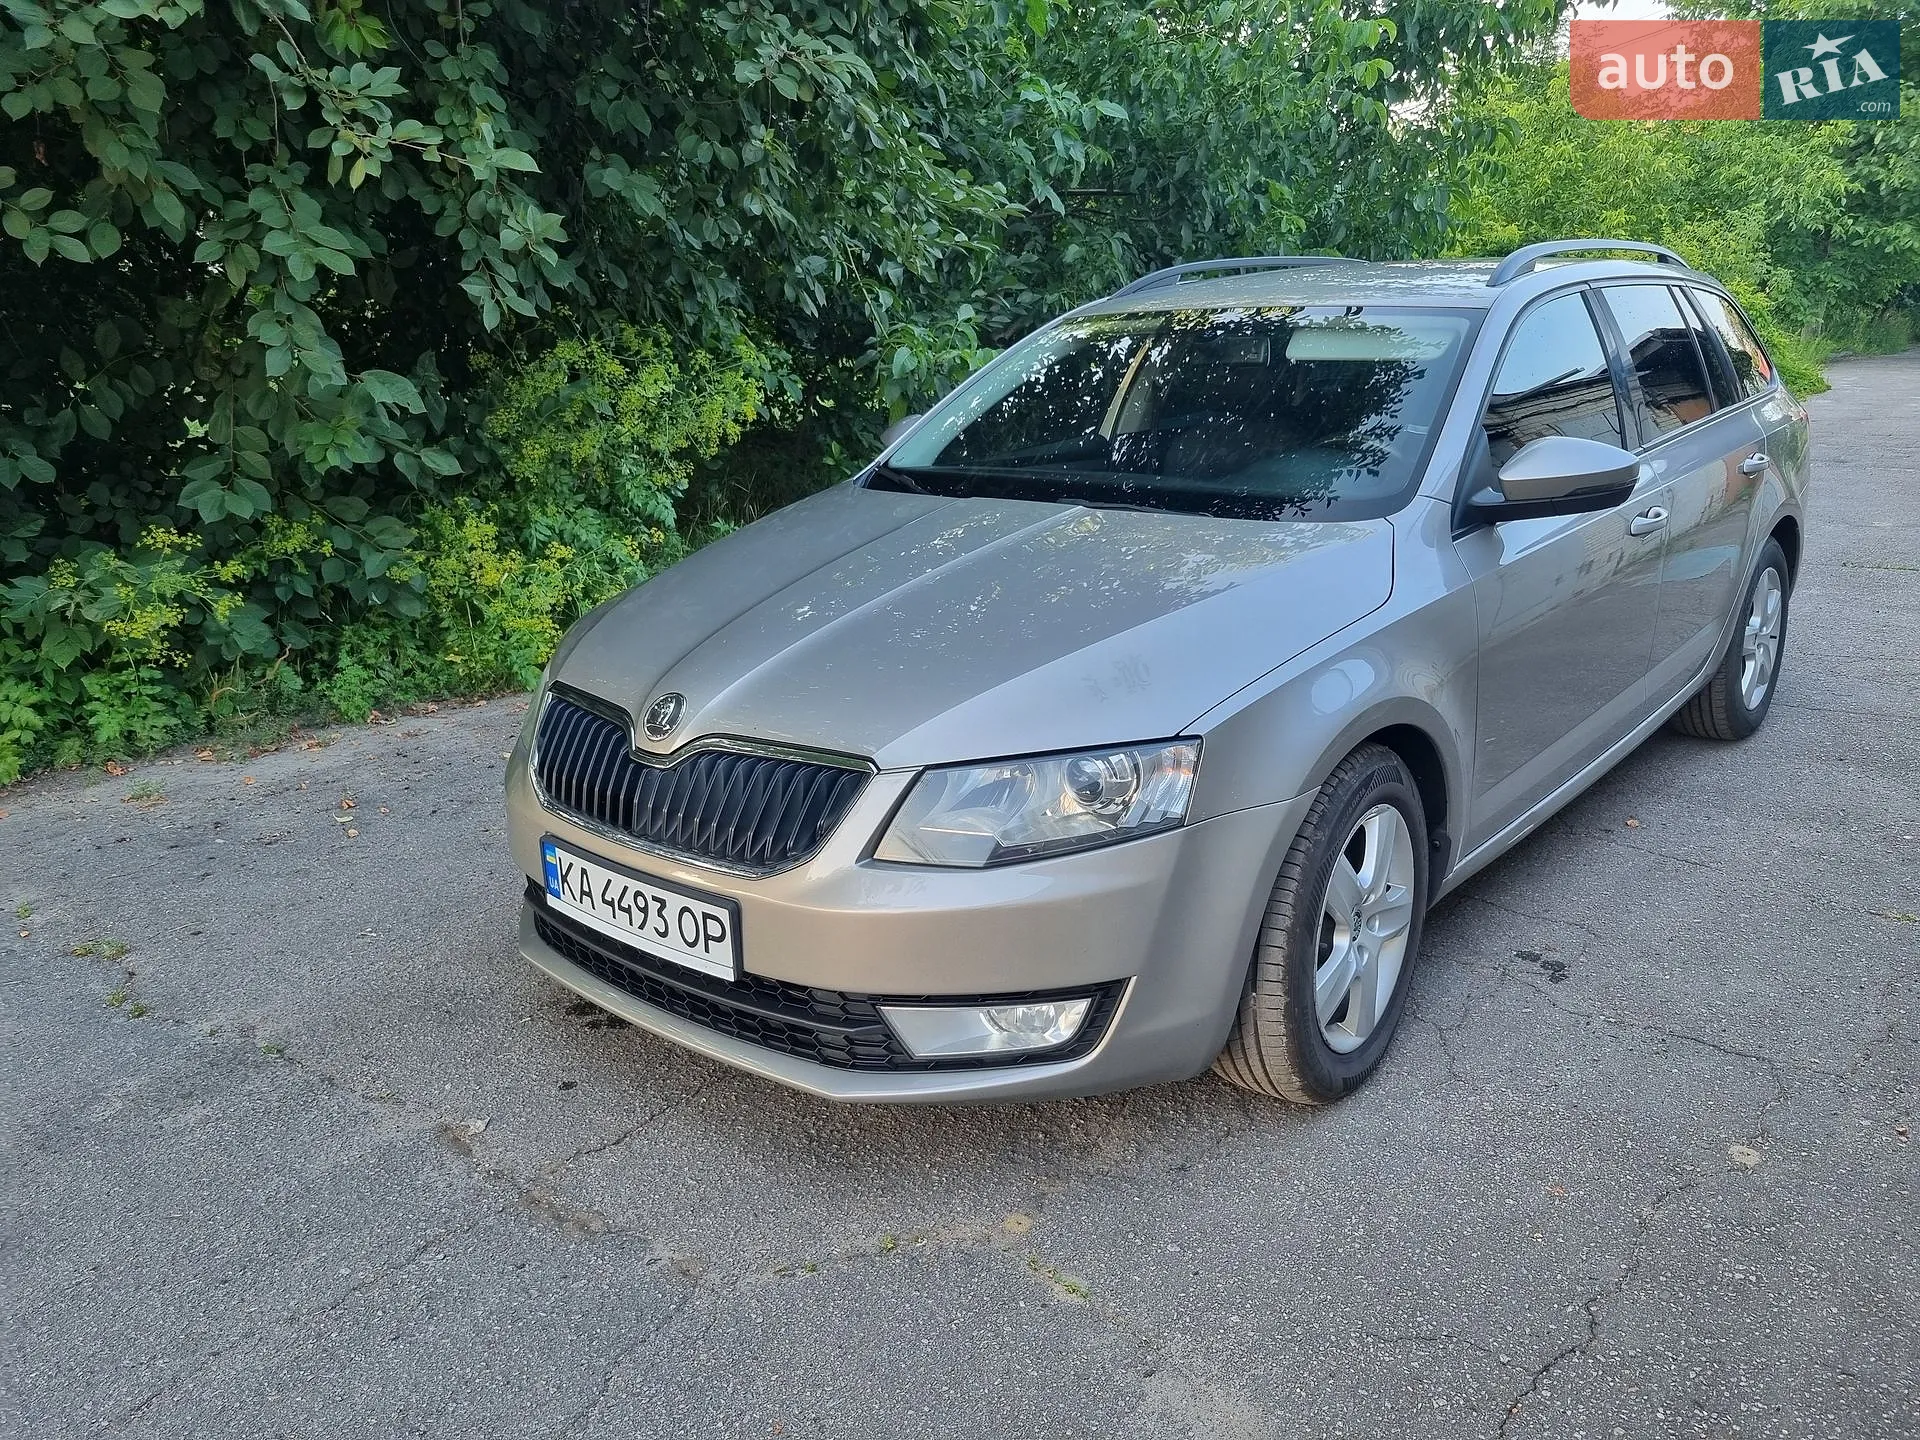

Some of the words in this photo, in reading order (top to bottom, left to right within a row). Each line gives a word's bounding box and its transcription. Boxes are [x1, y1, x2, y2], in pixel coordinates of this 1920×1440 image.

[549, 876, 560, 891] UA
[558, 857, 596, 911] KA
[601, 879, 669, 939] 4493
[678, 905, 727, 954] OP
